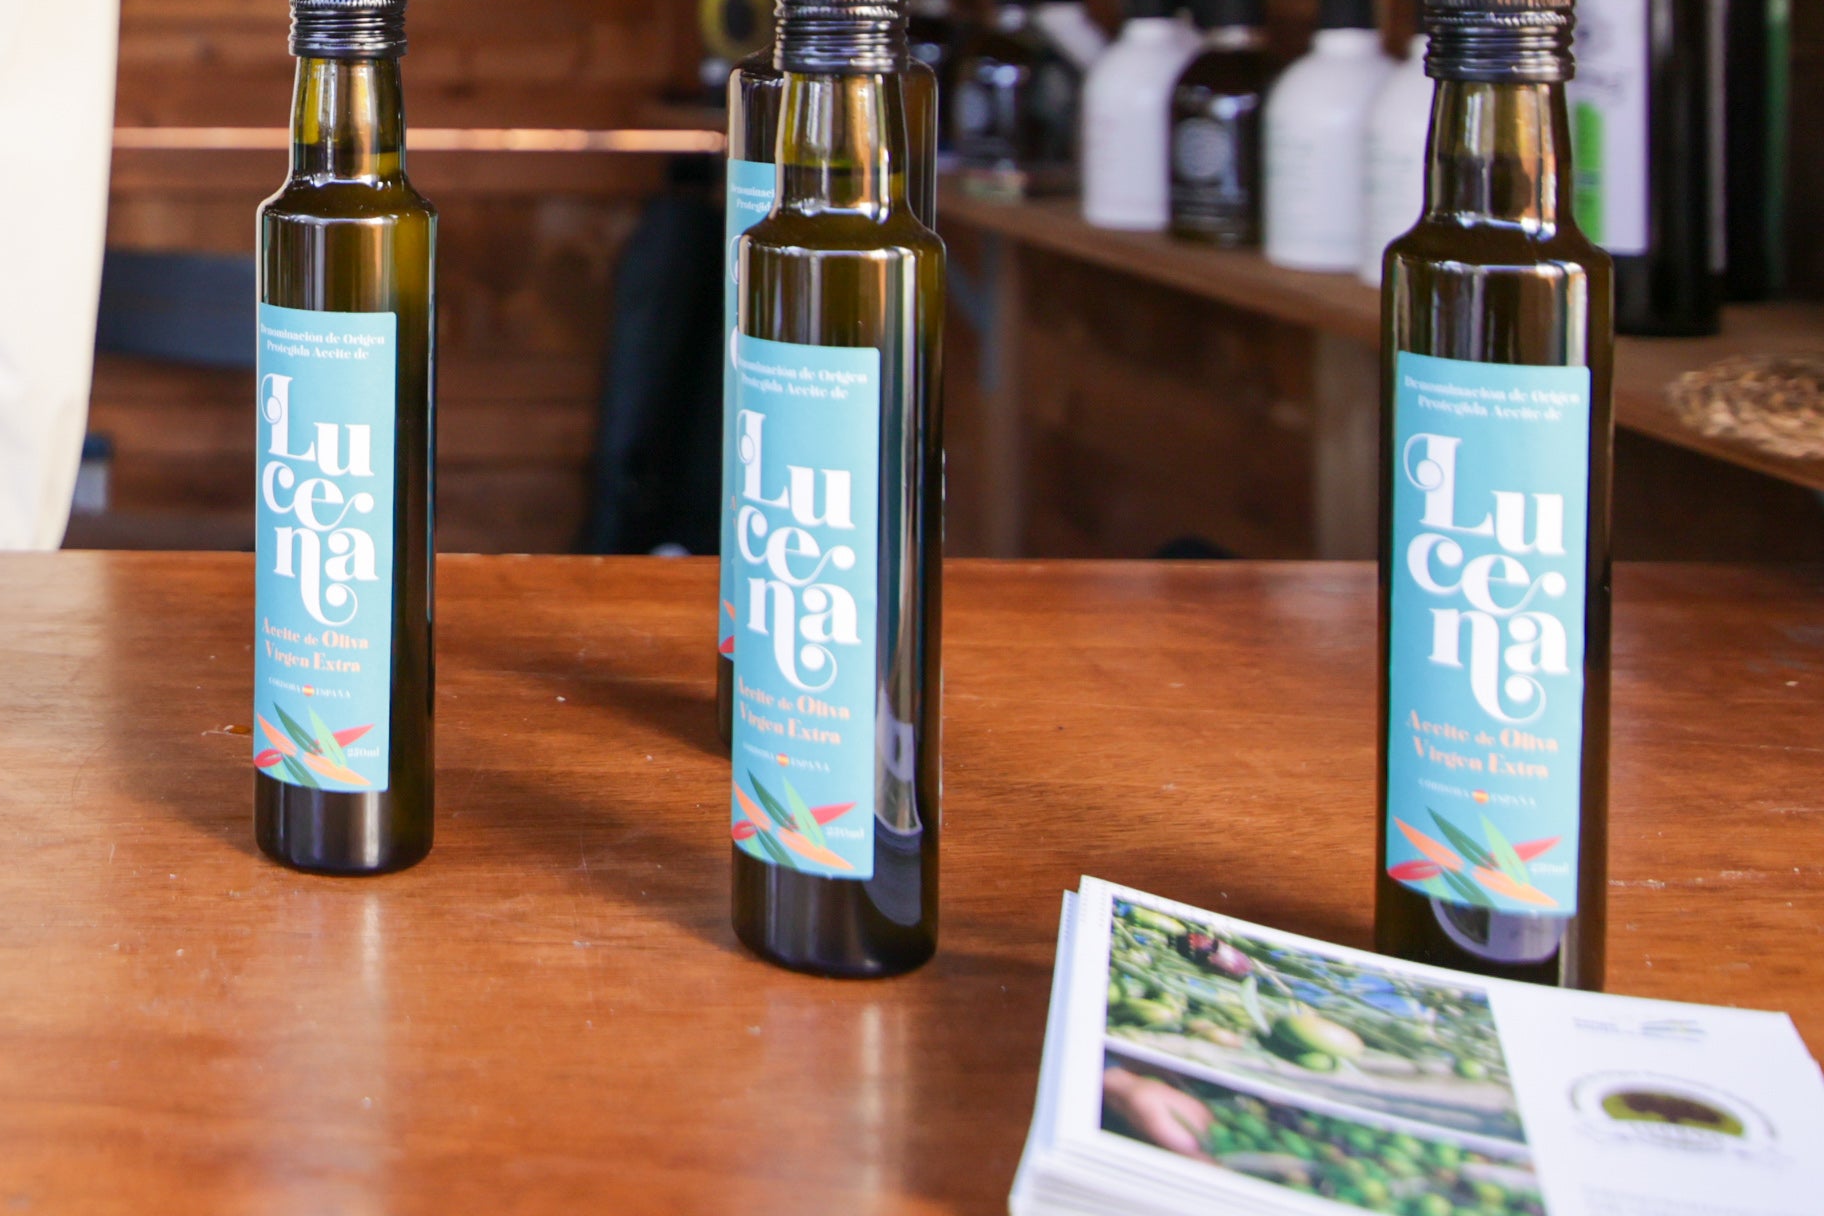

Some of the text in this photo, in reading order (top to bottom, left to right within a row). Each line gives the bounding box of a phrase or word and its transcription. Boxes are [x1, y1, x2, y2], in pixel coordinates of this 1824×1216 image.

[267, 339, 369, 360] Protegida Aceite de
[325, 332, 341, 344] de
[343, 333, 385, 346] Origen
[786, 381, 829, 398] Aceite
[831, 385, 849, 400] de
[819, 368, 869, 385] Origen
[260, 372, 375, 477] Lu
[737, 408, 856, 530] Lu
[262, 460, 375, 532] ce
[1403, 432, 1567, 556] Lu
[738, 504, 856, 588] ce
[273, 526, 380, 627] na
[1407, 532, 1568, 618] ce
[263, 616, 369, 650] Aceite de Oliva
[747, 576, 862, 692] na
[265, 639, 362, 673] Virgen Extra
[1428, 607, 1571, 725] na
[778, 696, 794, 711] de
[797, 695, 851, 720] Oliva
[788, 718, 842, 745] Extra
[1407, 709, 1560, 753] Aceite de Oliva
[1413, 735, 1550, 780] Virgen Extra
